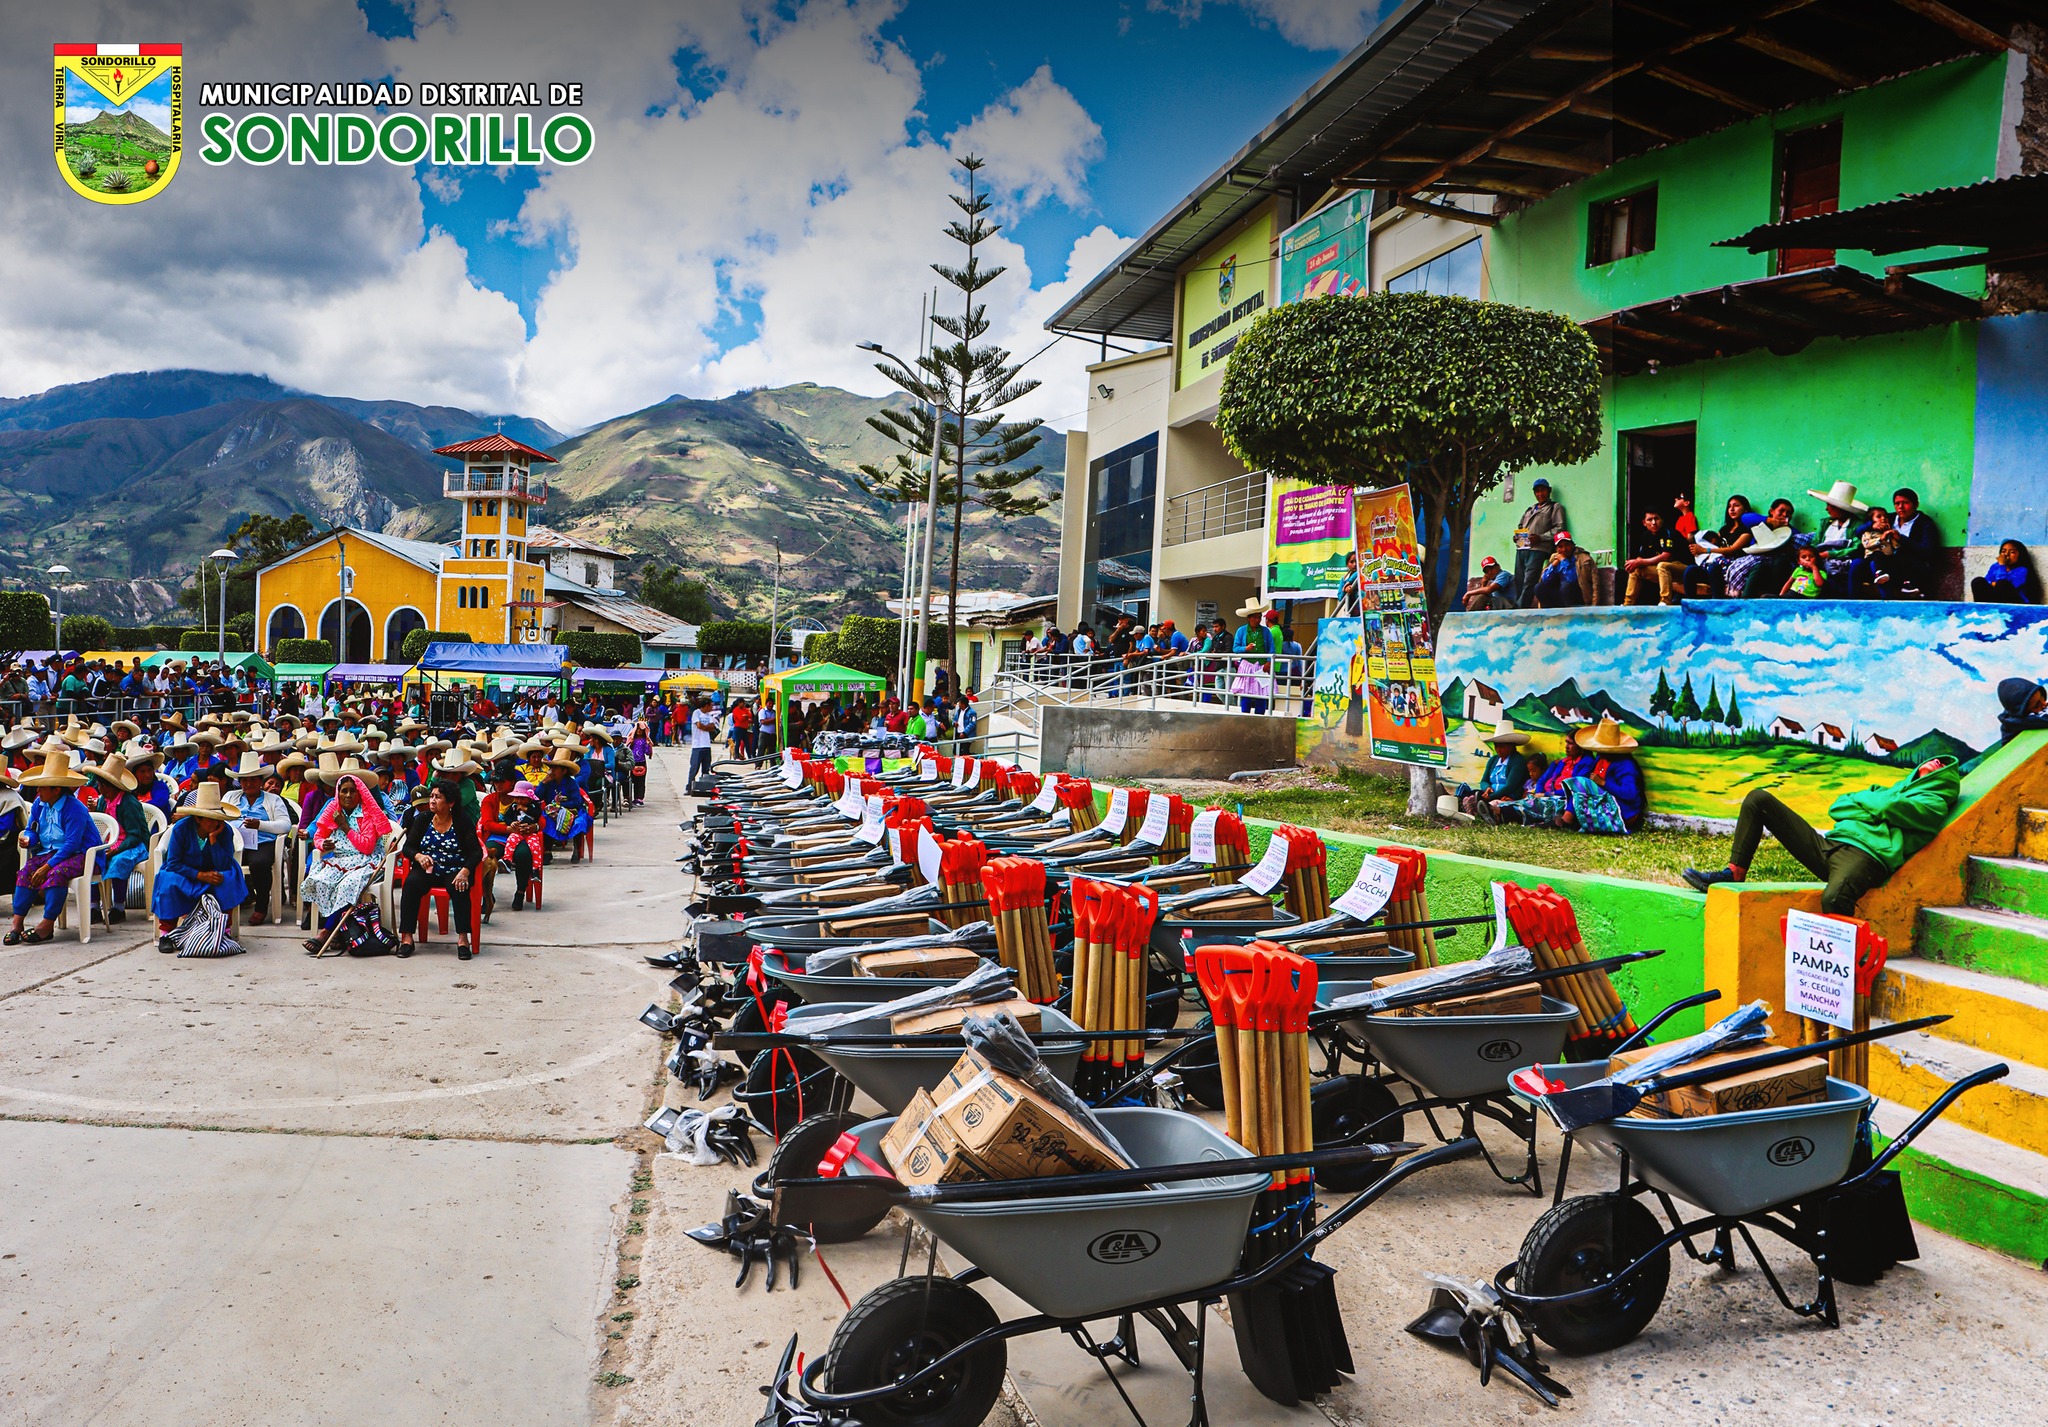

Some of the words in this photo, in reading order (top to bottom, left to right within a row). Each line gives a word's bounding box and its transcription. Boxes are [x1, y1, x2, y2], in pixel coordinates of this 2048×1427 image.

[1189, 310, 1231, 349] MUNICIPALIDAD
[1232, 289, 1264, 323] DISTRITAL
[1372, 872, 1381, 883] LA
[1355, 881, 1388, 899] SOCCHA
[1809, 937, 1833, 954] LAS
[1792, 951, 1850, 979] PAMPAS
[1799, 978, 1810, 988] Sr.
[1811, 981, 1841, 997] CECILIO
[1800, 990, 1840, 1009] MANCHAY
[1801, 1002, 1839, 1021] HUANCAY
[1484, 1041, 1516, 1059] C&A
[1774, 1139, 1809, 1162] C&A
[1098, 1233, 1152, 1260] C&A
